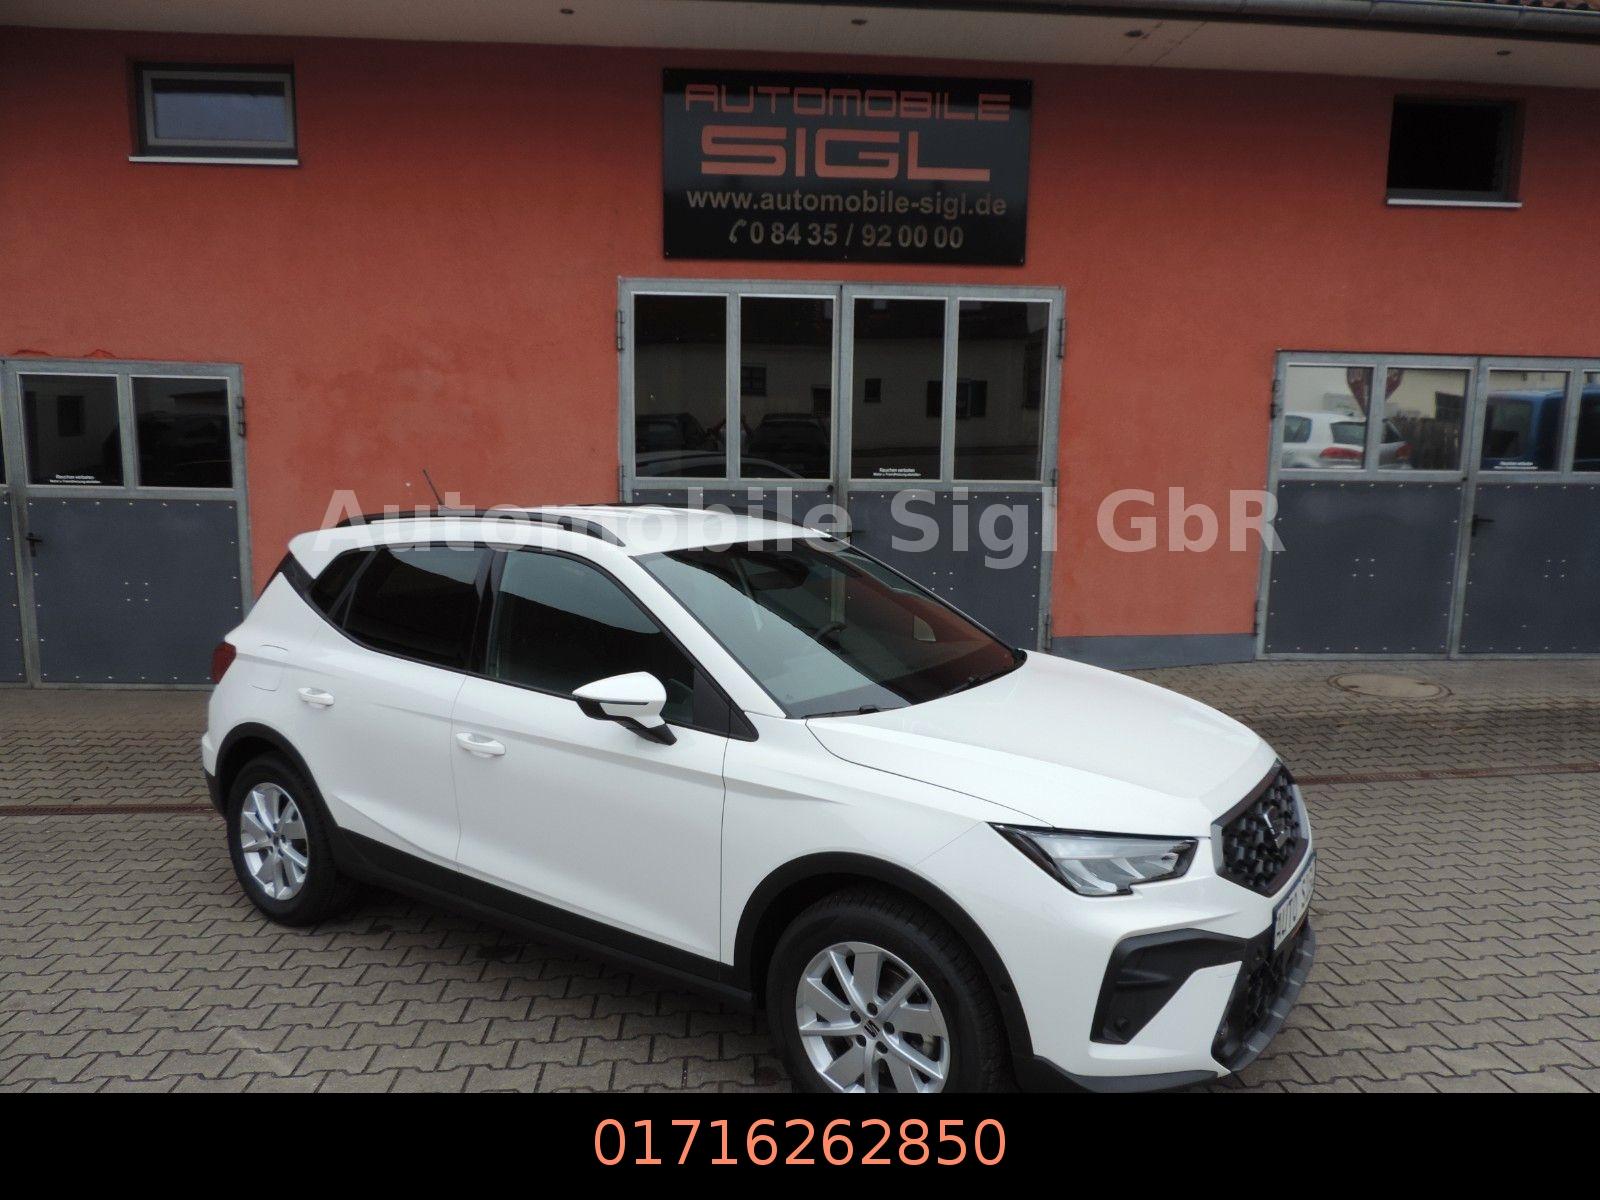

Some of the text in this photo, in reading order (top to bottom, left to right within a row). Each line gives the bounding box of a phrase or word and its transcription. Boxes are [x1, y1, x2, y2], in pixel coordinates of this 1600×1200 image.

[685, 84, 1011, 121] AUTOMOBILE
[701, 125, 991, 182] SIGL
[687, 189, 1007, 220] www.automobile-sigl.de
